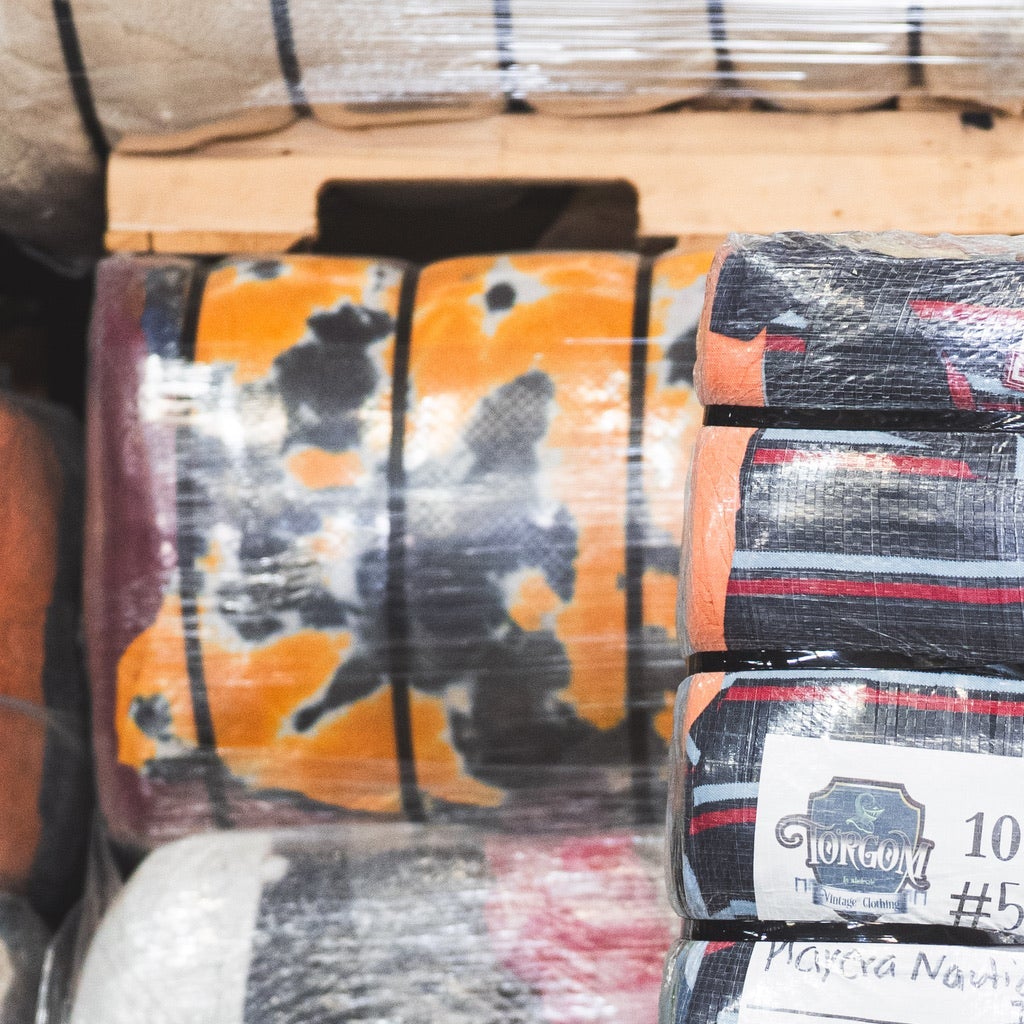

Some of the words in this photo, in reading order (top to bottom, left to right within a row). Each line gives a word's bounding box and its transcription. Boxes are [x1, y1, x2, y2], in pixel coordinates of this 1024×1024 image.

[775, 813, 935, 890] TORGOM
[822, 889, 857, 907] Vintage
[863, 897, 899, 911] Clothing
